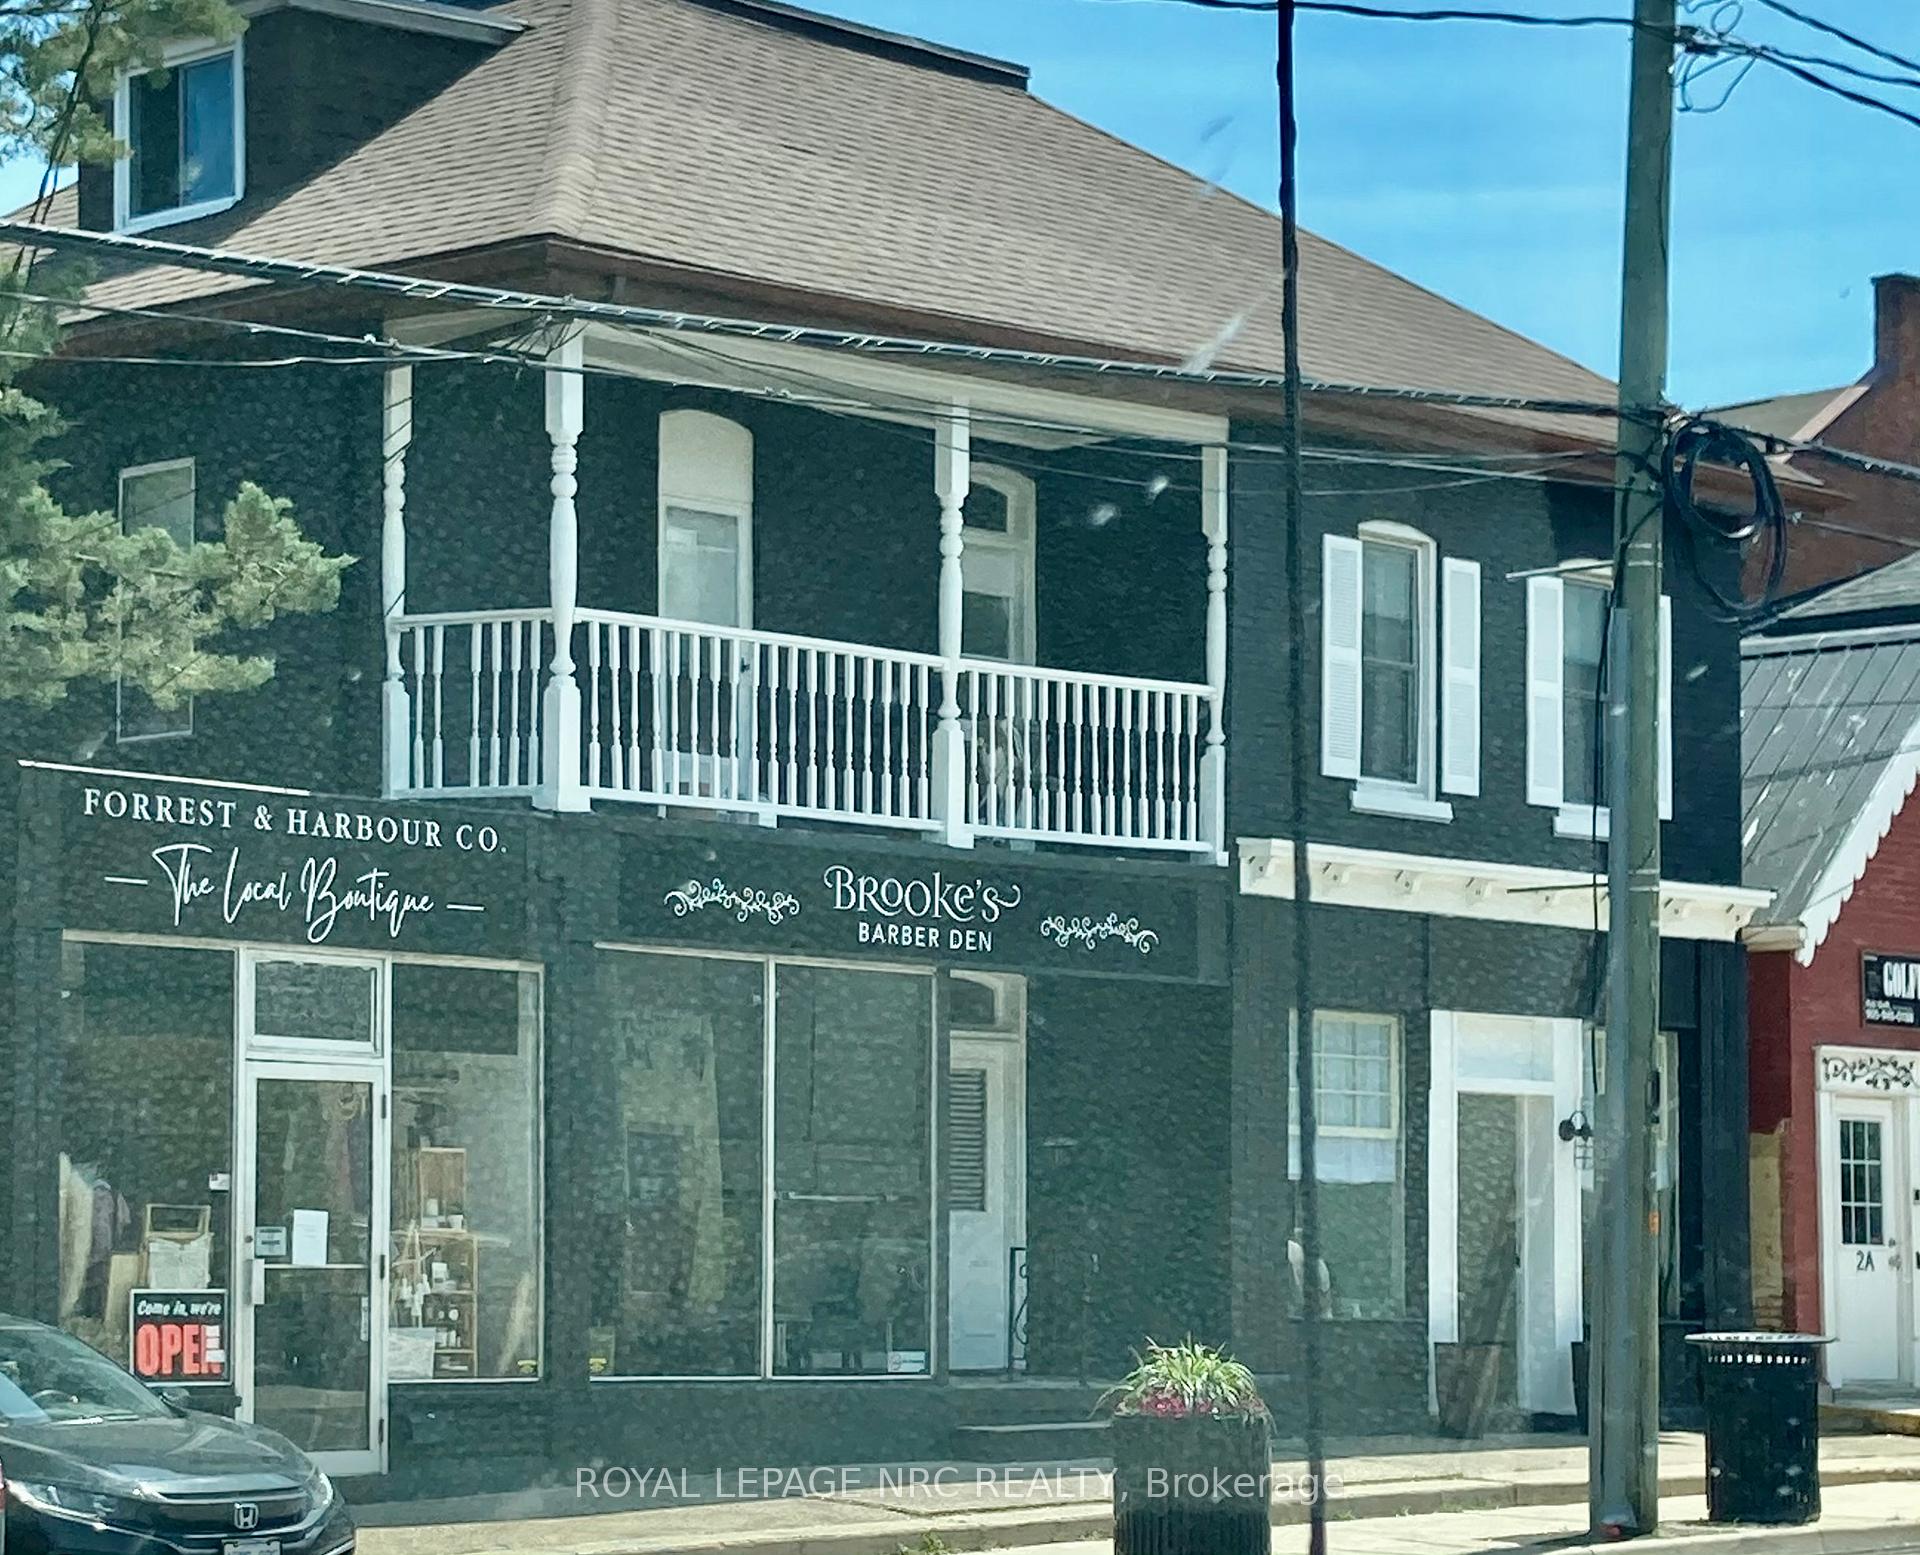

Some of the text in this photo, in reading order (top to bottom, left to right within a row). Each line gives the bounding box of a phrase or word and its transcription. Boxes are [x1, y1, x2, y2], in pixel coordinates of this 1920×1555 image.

[83, 788, 508, 854] FORREST & HARBOUR CO.
[152, 843, 435, 944] The Local Boutique
[858, 923, 993, 953] BARBER DEN
[1856, 1249, 1876, 1272] 2A
[137, 1300, 170, 1315] Come
